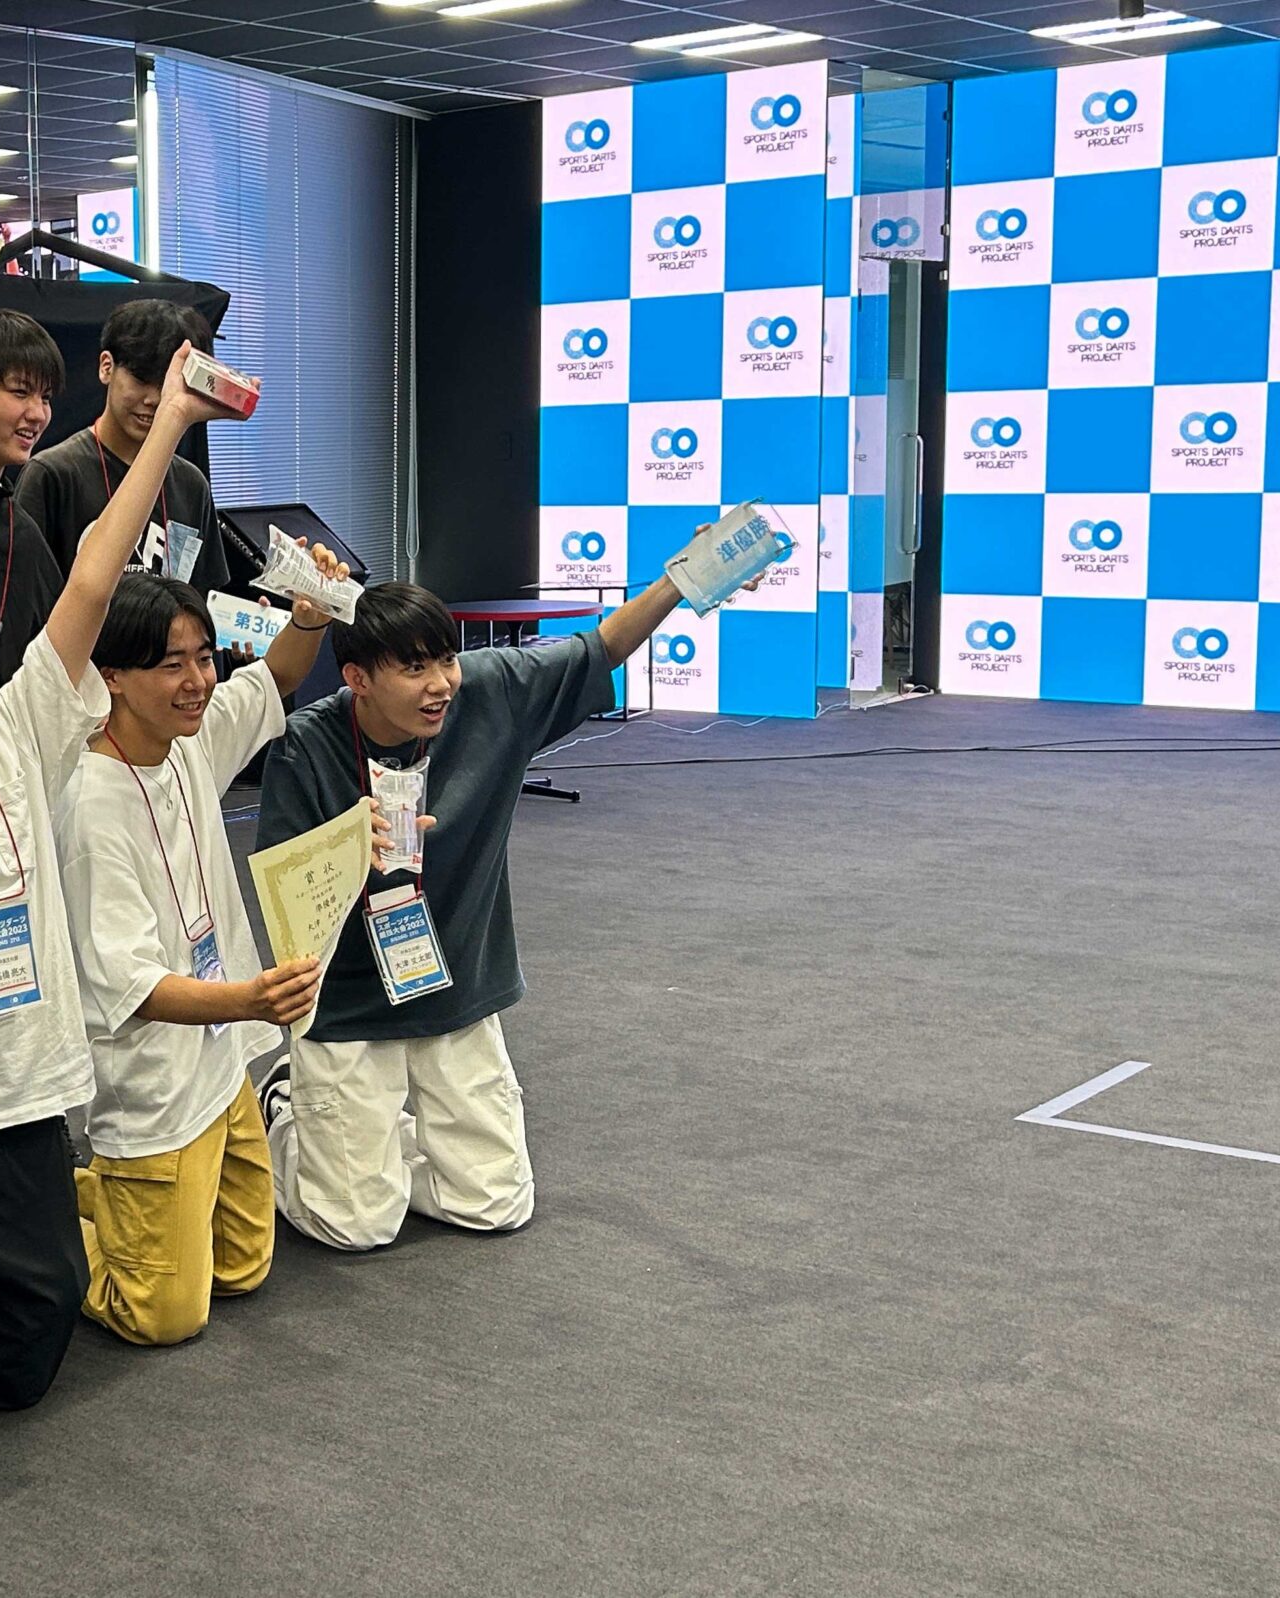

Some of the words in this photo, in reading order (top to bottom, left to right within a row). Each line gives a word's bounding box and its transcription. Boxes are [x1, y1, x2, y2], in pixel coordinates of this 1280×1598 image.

[1074, 127, 1110, 139] SPORTS
[1114, 123, 1143, 134] DARTS
[744, 131, 776, 144] SPORTS
[780, 129, 807, 140] DARTS
[1088, 135, 1129, 147] PROJECT
[756, 141, 794, 153] PROJECT
[560, 154, 588, 166] SPORTS
[592, 152, 616, 162] DARTS
[571, 163, 604, 174] PROJECT
[1180, 227, 1217, 238] SPORTS
[1221, 225, 1253, 235] DARTS
[1194, 237, 1238, 247] PROJECT
[969, 244, 1002, 254] SPORTS
[1006, 242, 1033, 251] DARTS
[648, 252, 678, 262] SPORTS
[681, 249, 707, 259] DARTS
[982, 252, 1019, 262] PROJECT
[659, 260, 694, 270] PROJECT
[1068, 343, 1102, 353] SPORTS
[1106, 342, 1136, 351] DARTS
[740, 353, 773, 362] SPORTS
[776, 351, 803, 360] DARTS
[1081, 353, 1122, 362] PROJECT
[558, 362, 586, 371] SPORTS
[589, 361, 613, 370] DARTS
[753, 362, 790, 372] PROJECT
[569, 372, 601, 380] PROJECT
[964, 451, 996, 459] SPORTS
[1000, 451, 1027, 459] DARTS
[1172, 448, 1208, 456] SPORTS
[1213, 448, 1243, 456] DARTS
[645, 462, 675, 471] SPORTS
[678, 462, 704, 470] DARTS
[976, 461, 1014, 469] PROJECT
[1186, 458, 1228, 467] PROJECT
[657, 472, 692, 480] PROJECT
[716, 514, 770, 563] 準優勝
[1062, 554, 1096, 562] SPORTS
[1100, 555, 1128, 563] DARTS
[556, 564, 584, 572] SPORTS
[772, 567, 800, 576] DARTS
[234, 611, 280, 637] 第3位
[959, 653, 991, 661] SPORTS
[995, 655, 1022, 663] DARTS
[971, 663, 1008, 671] PROJECT
[1165, 662, 1200, 671] SPORTS
[1205, 664, 1235, 673] DARTS
[676, 669, 701, 677] DARTS
[1178, 673, 1220, 682] PROJECT
[655, 677, 689, 686] PROJECT
